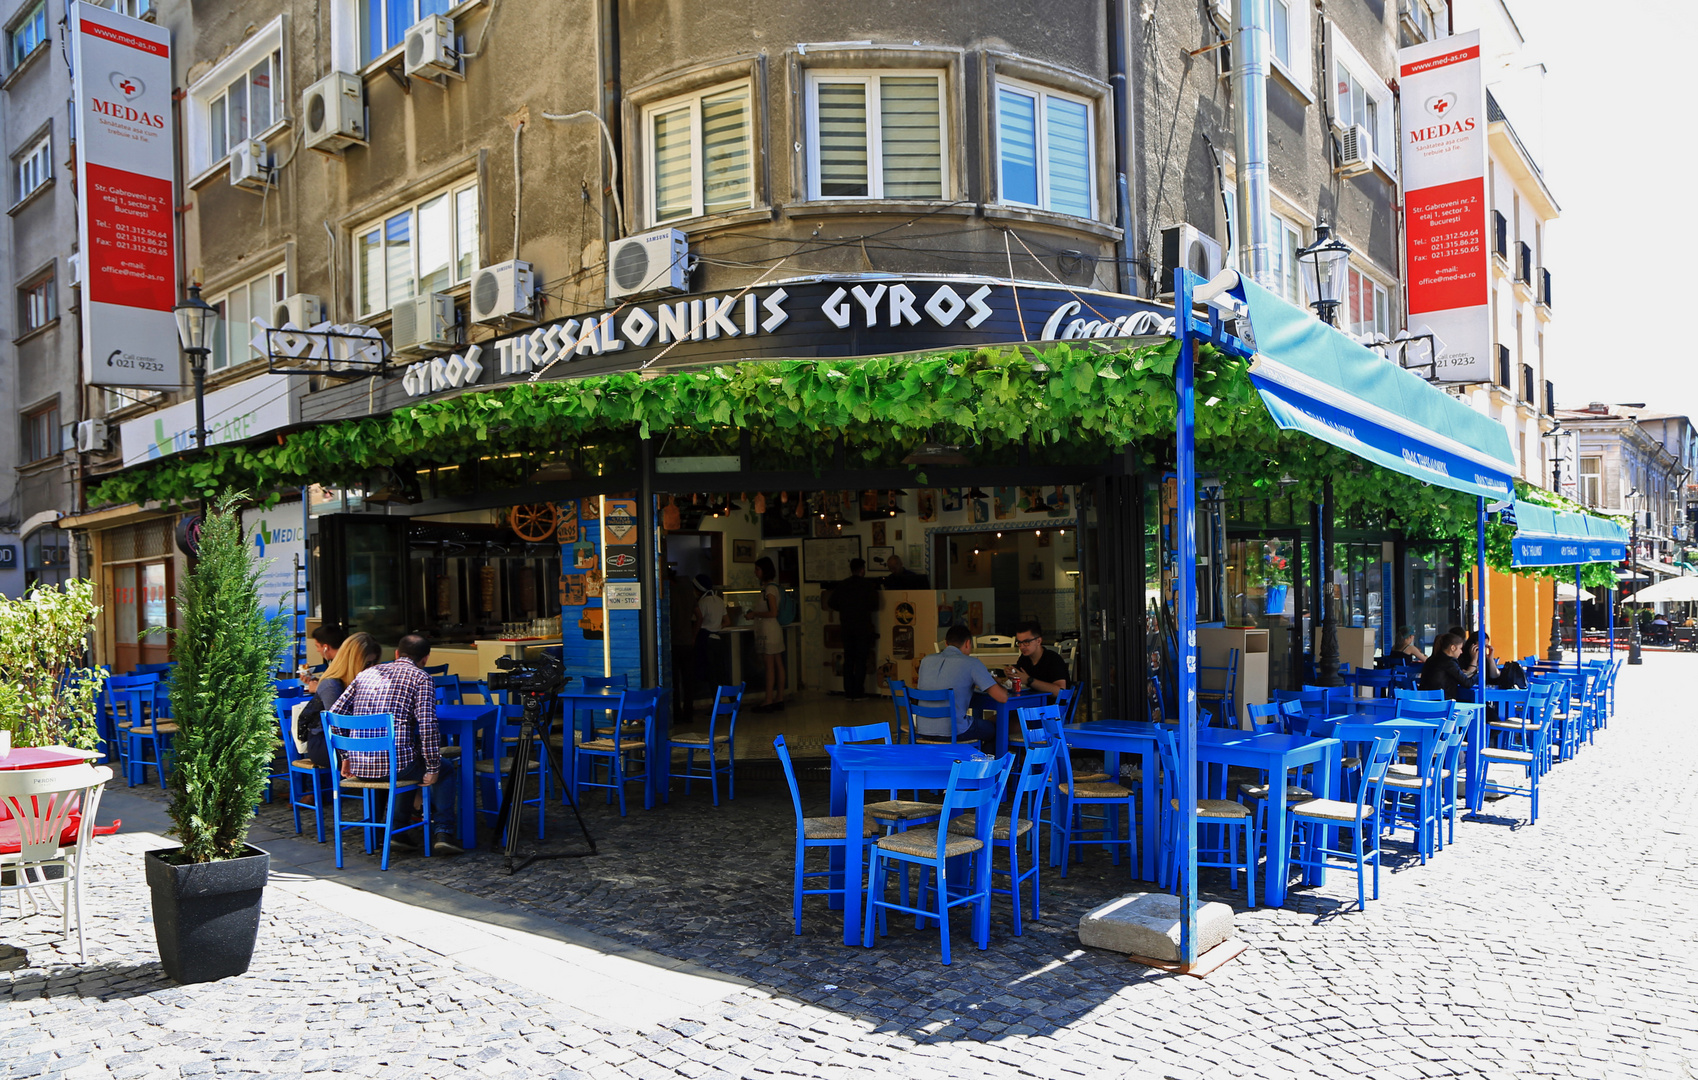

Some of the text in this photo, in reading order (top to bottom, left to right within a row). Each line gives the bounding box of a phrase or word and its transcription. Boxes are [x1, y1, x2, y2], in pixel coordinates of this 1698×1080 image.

[94, 27, 157, 52] www.med-as.ro
[1411, 52, 1468, 72] www.med-as.ro
[92, 98, 165, 129] MEDAS
[107, 127, 131, 138] trebuie
[1409, 117, 1476, 144] MEDAS
[1456, 135, 1470, 143] cum
[1423, 148, 1444, 157] trebuie
[94, 183, 108, 193] Str.
[109, 186, 148, 201] Gabroveni
[148, 195, 157, 203] nr.
[103, 194, 118, 205] etaj
[128, 199, 151, 211] sector
[1412, 206, 1424, 214] Str.
[1425, 199, 1460, 212] Gabroveni
[1460, 197, 1471, 205] nr.
[1419, 211, 1433, 221] etaj
[1441, 206, 1463, 217] sector
[115, 223, 168, 239] 021.312.50.64
[646, 233, 669, 243] SAMSUNG
[1430, 229, 1479, 243] 021.312.50.64
[96, 237, 168, 256] Fax: 021.312.50.65
[116, 232, 168, 248] 021.315.86.23
[1431, 237, 1479, 251] 021.315.86.23
[1414, 245, 1480, 262] Fax: 021.312.50.65
[121, 260, 146, 270] e-mail:
[496, 264, 513, 273] SAMSUNG
[1435, 266, 1459, 275] e-mail:
[101, 265, 165, 282] office@med-as.ro
[1418, 271, 1476, 286] office@med-as.ro
[402, 283, 993, 397] GYROS THESSALONIKIS GYROS
[116, 359, 165, 372] 021 9232
[1436, 357, 1476, 368] 21 9232
